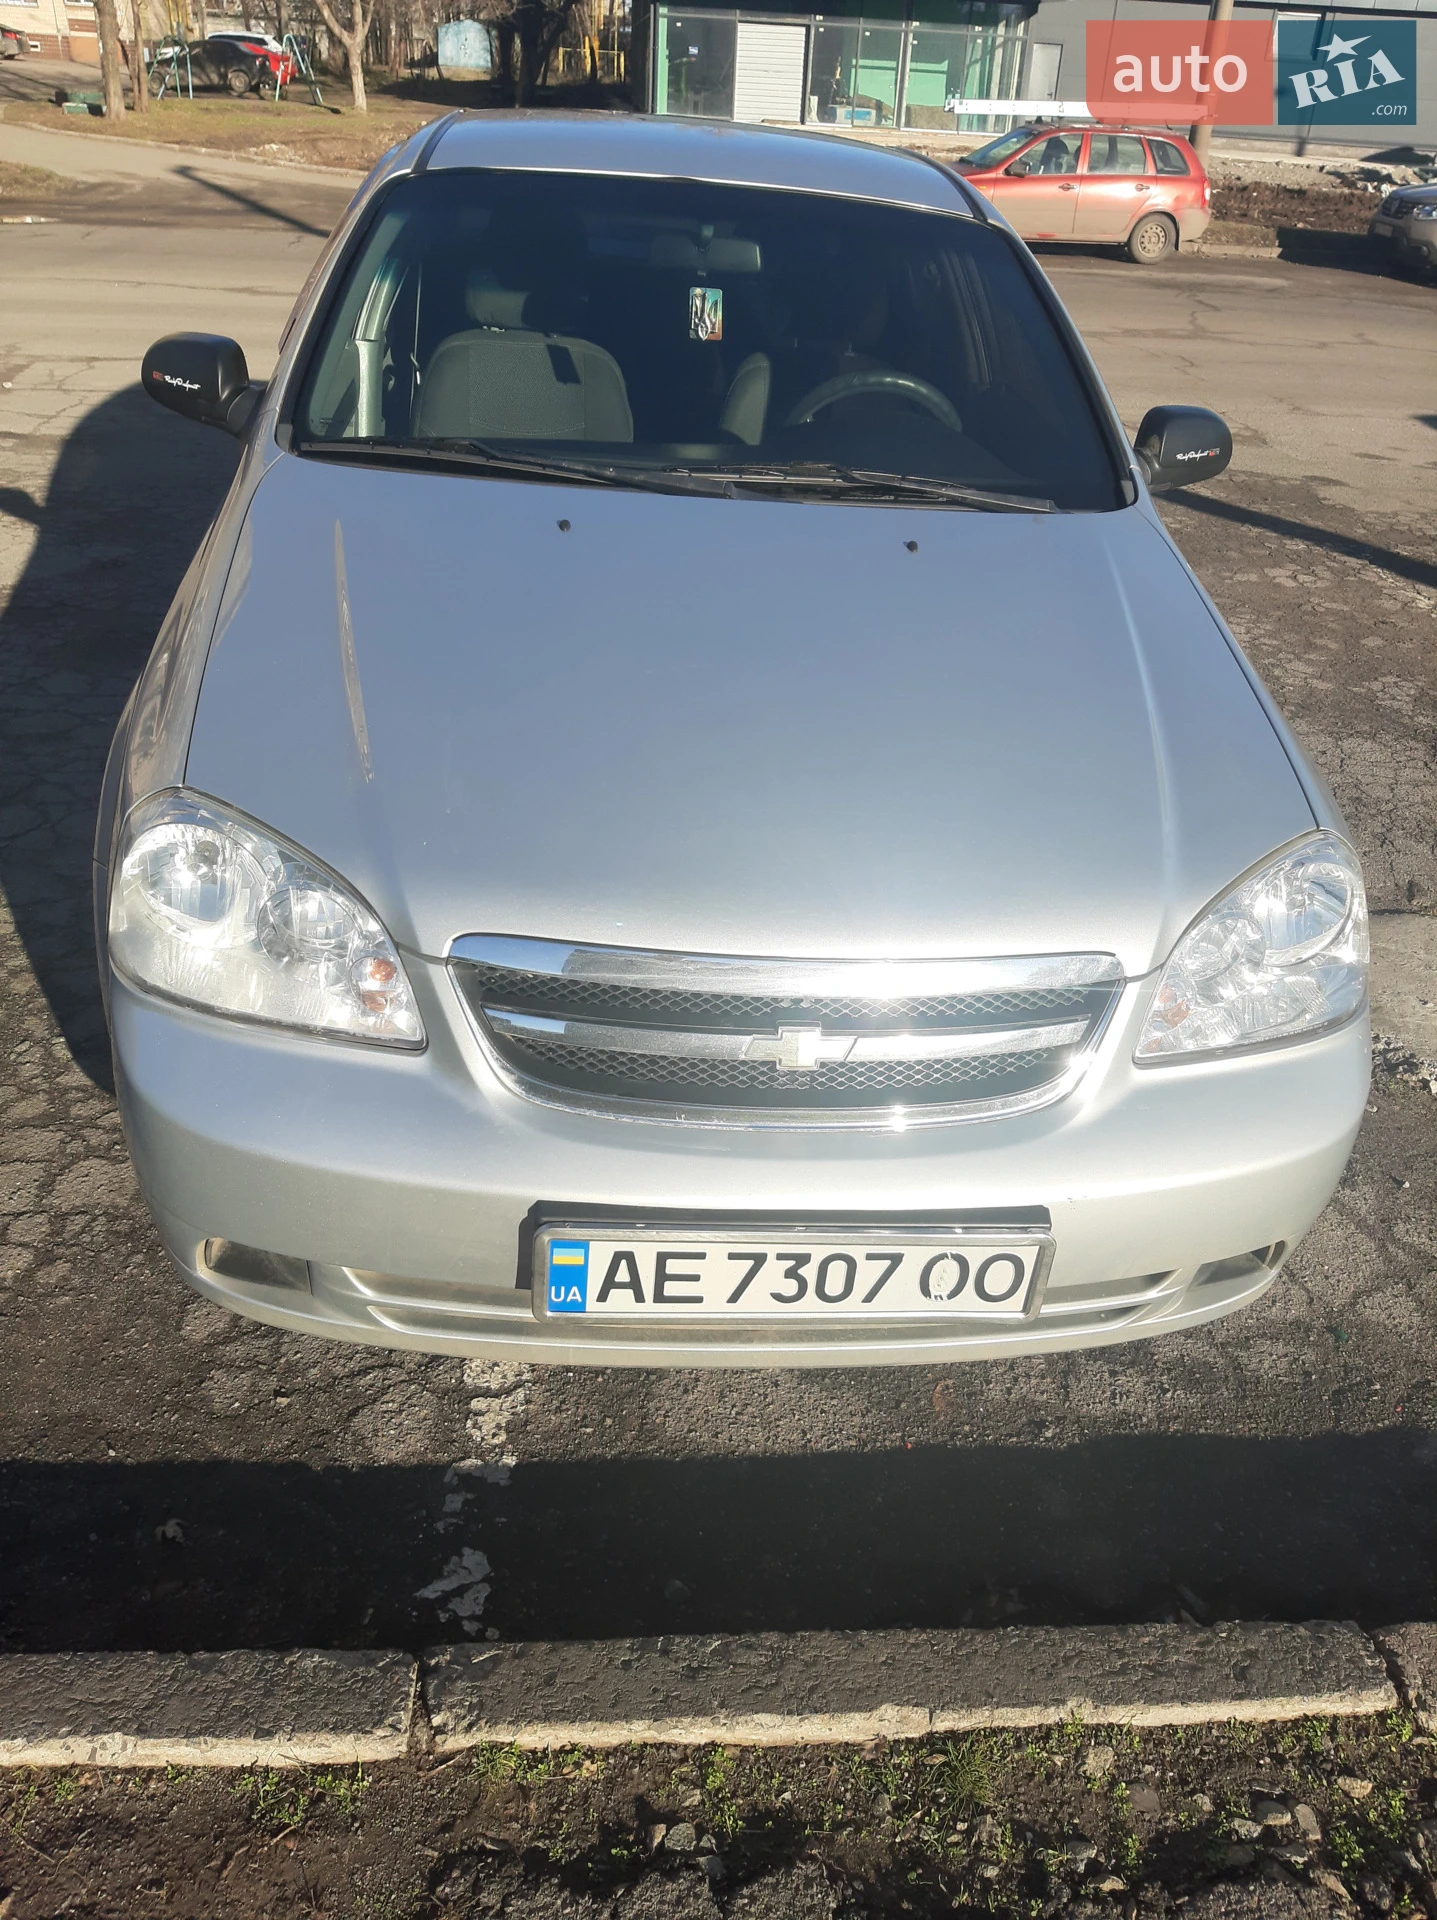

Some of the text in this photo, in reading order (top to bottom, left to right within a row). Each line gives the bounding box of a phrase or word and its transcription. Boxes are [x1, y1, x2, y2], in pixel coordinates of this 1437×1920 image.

[550, 1286, 583, 1304] UA
[595, 1250, 1026, 1304] AE 7307 OO
